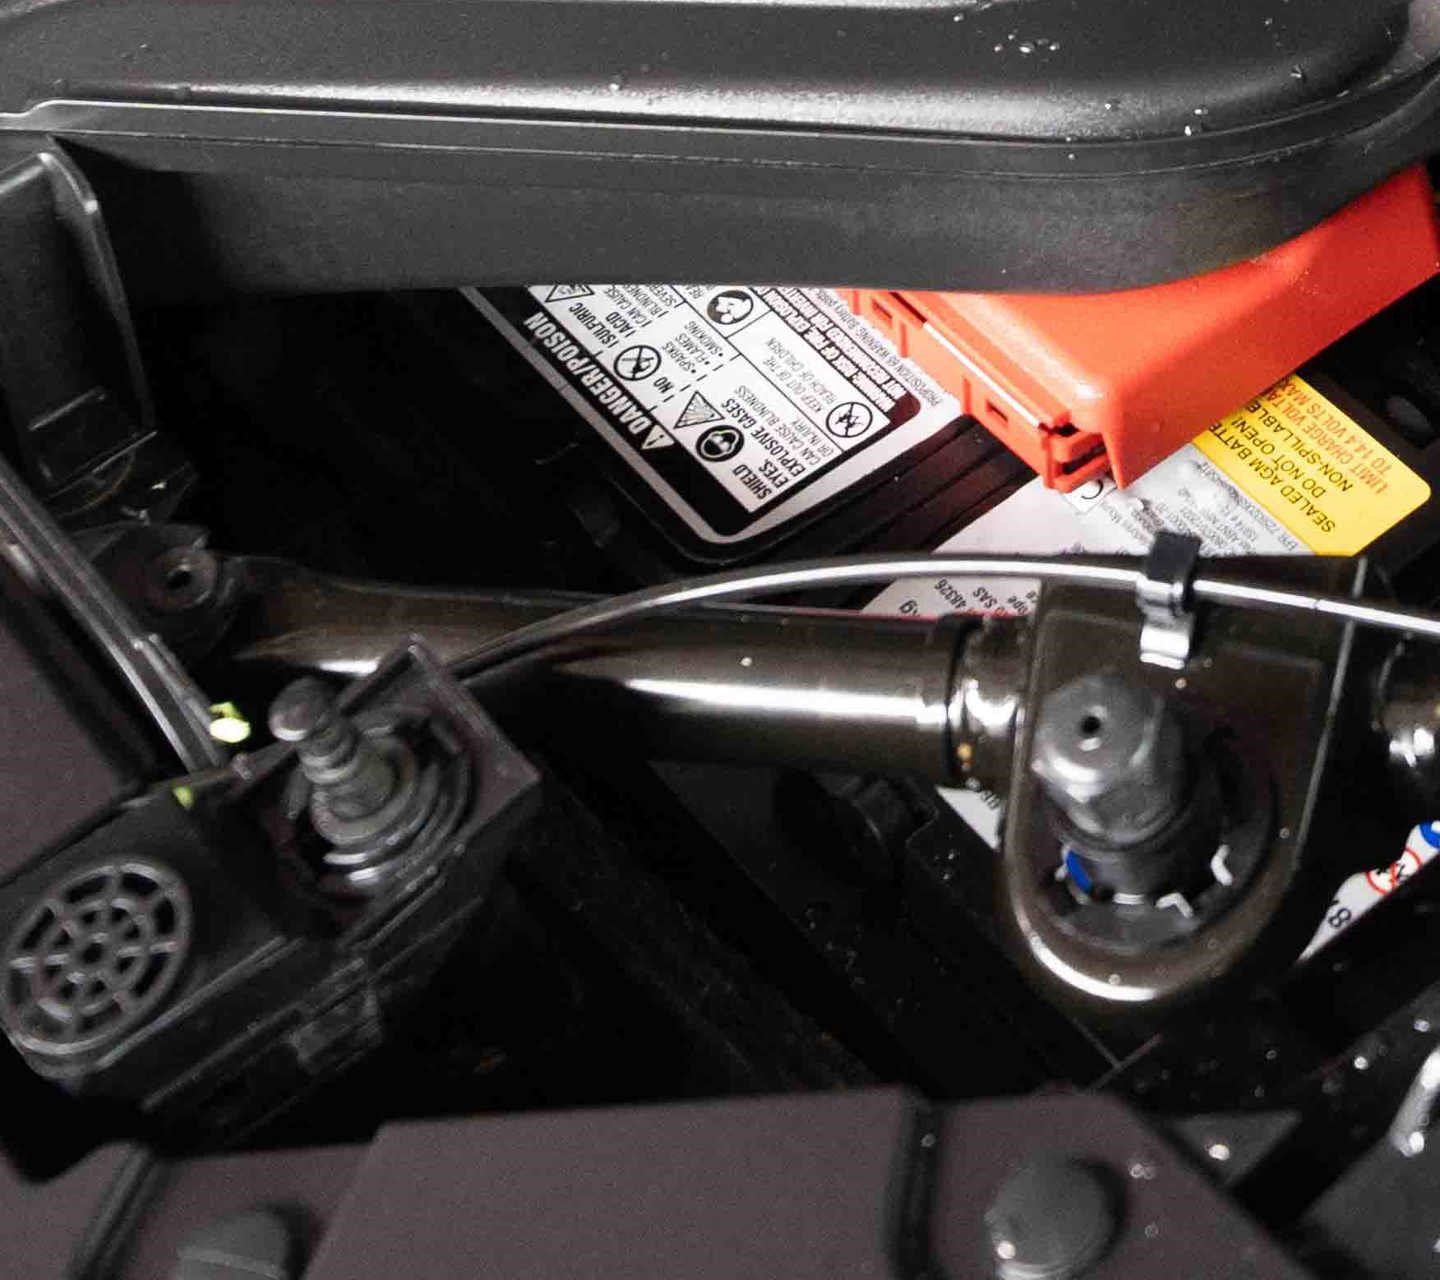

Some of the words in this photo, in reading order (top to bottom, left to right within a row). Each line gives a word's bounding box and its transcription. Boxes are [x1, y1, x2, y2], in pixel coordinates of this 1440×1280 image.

[604, 286, 631, 310] CAUSE
[568, 301, 615, 344] SULFURIC
[605, 311, 632, 333] ACID
[627, 307, 646, 324] CAN
[763, 290, 810, 332] EXPLOSION
[811, 313, 833, 331] FOR
[763, 357, 781, 372] THE
[767, 338, 804, 371] CHILDREN
[821, 344, 840, 360] OF
[826, 327, 889, 384] RECOMMENDED
[524, 312, 652, 435] DANGER/POISON
[653, 376, 672, 392] NO
[776, 369, 791, 381] OF
[786, 378, 805, 394] OUT
[799, 369, 814, 382] OF
[810, 380, 836, 403] REACH
[881, 378, 905, 399] NOT
[721, 397, 756, 428] GASES
[734, 385, 778, 425] BLINDNESS
[801, 392, 823, 412] KEEP
[1306, 403, 1346, 437] VOLTS
[775, 424, 803, 449] CAUSE
[1231, 416, 1275, 454] OPEN!
[1246, 401, 1352, 492] NON-SPILLABLE
[1302, 421, 1353, 464] CHARGE
[1344, 434, 1372, 459] 14.4
[750, 426, 805, 476] EXPLOSIVE
[800, 448, 819, 465] CAN
[818, 444, 833, 456] OR
[1249, 458, 1282, 485] AGM
[1273, 454, 1304, 479] NOT
[1350, 462, 1387, 493] LIMIT
[1370, 456, 1391, 475] TO
[732, 464, 771, 499] SHIELD
[1301, 477, 1325, 497] DO
[1280, 484, 1335, 532] SEALED
